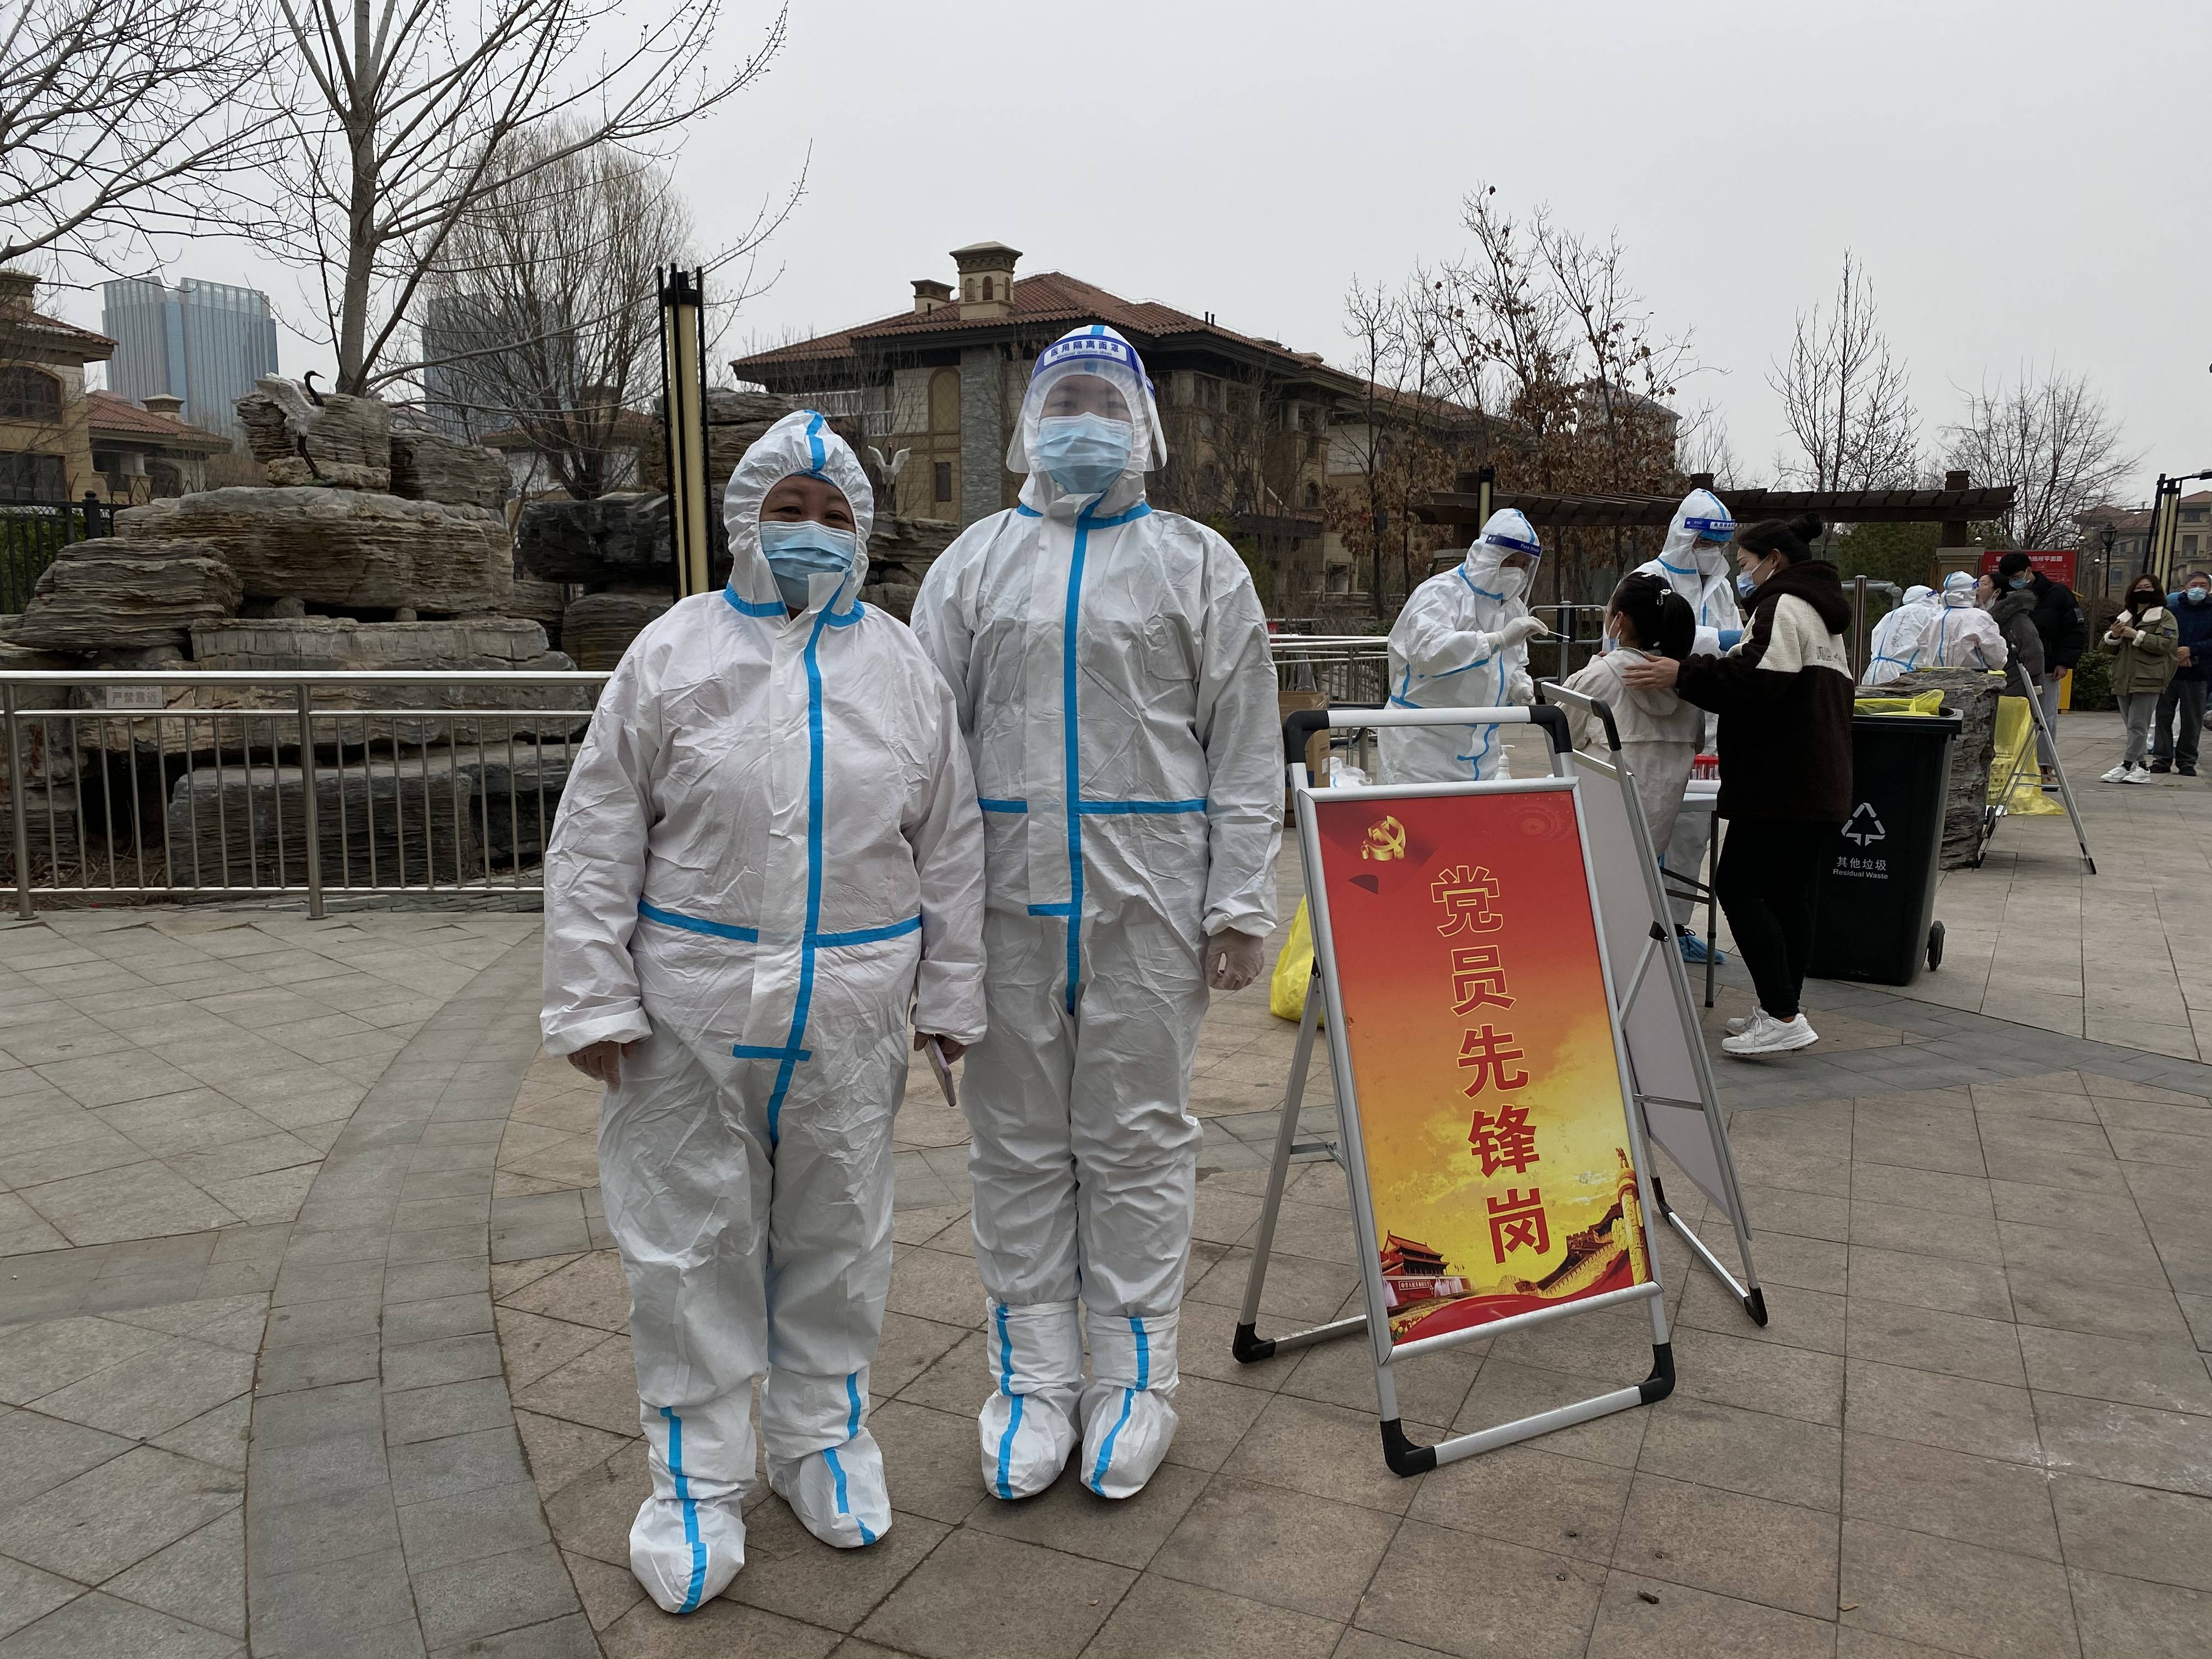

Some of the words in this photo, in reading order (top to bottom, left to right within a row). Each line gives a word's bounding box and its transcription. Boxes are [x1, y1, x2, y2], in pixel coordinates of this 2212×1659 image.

[1051, 340, 1119, 357] 医用隔离面罩
[112, 691, 157, 703] 严禁靠近
[1836, 856, 1887, 871] 其他垃圾
[1832, 868, 1864, 877] Residual
[1865, 871, 1888, 879] Waste
[1431, 865, 1550, 1265] 党员先锋岗
